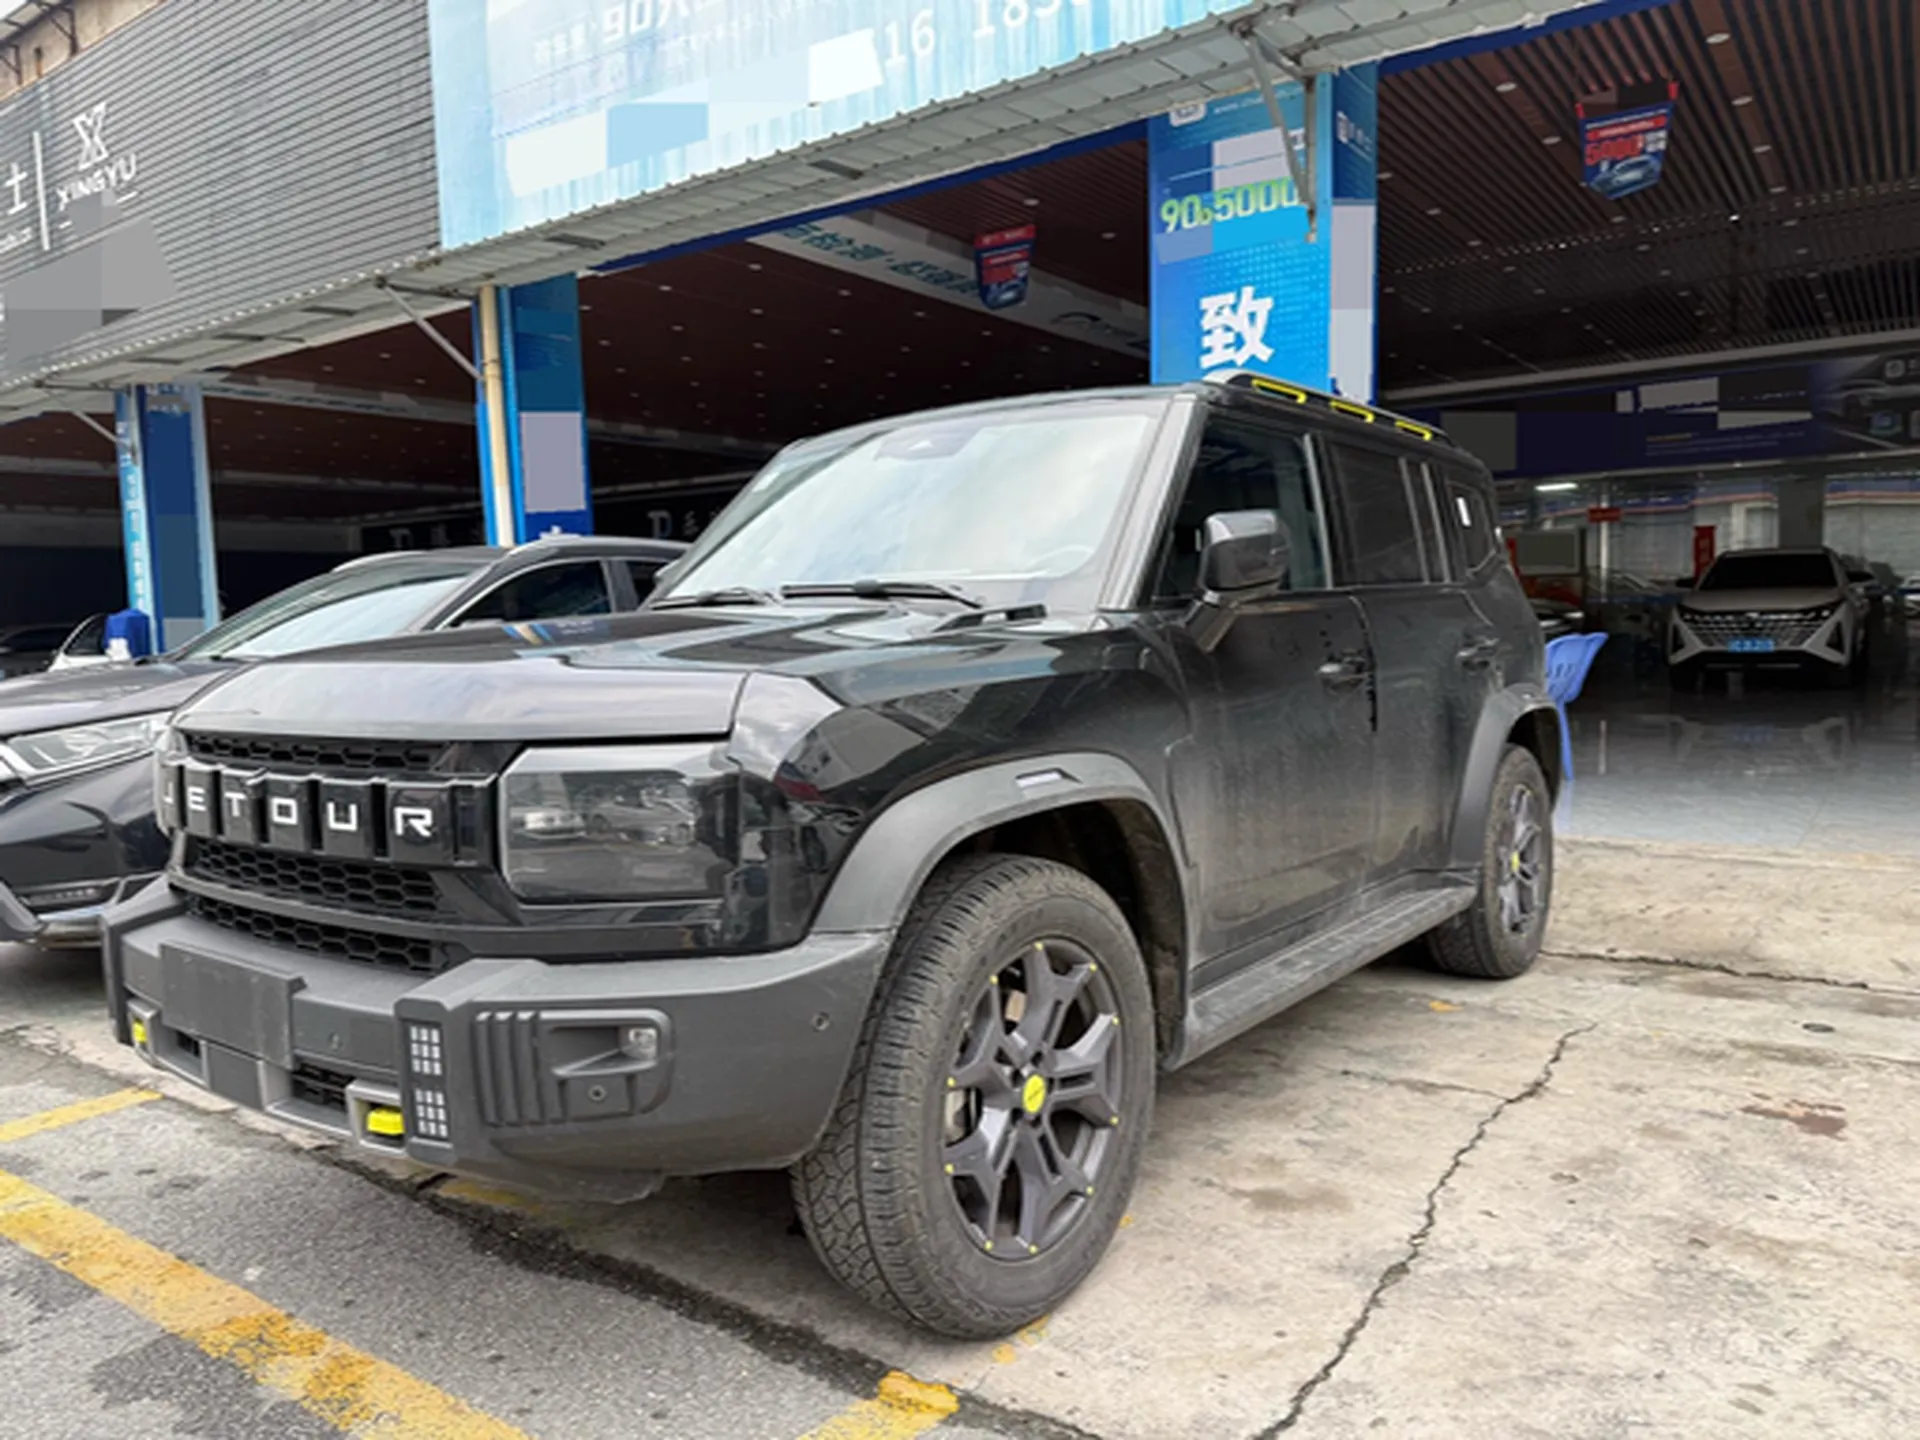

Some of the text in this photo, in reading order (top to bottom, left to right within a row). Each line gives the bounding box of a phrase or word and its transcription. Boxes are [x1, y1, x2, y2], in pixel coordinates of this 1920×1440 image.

[56, 153, 137, 211] XINGYU
[1199, 285, 1275, 369] 致
[163, 782, 434, 836] JETOUR
